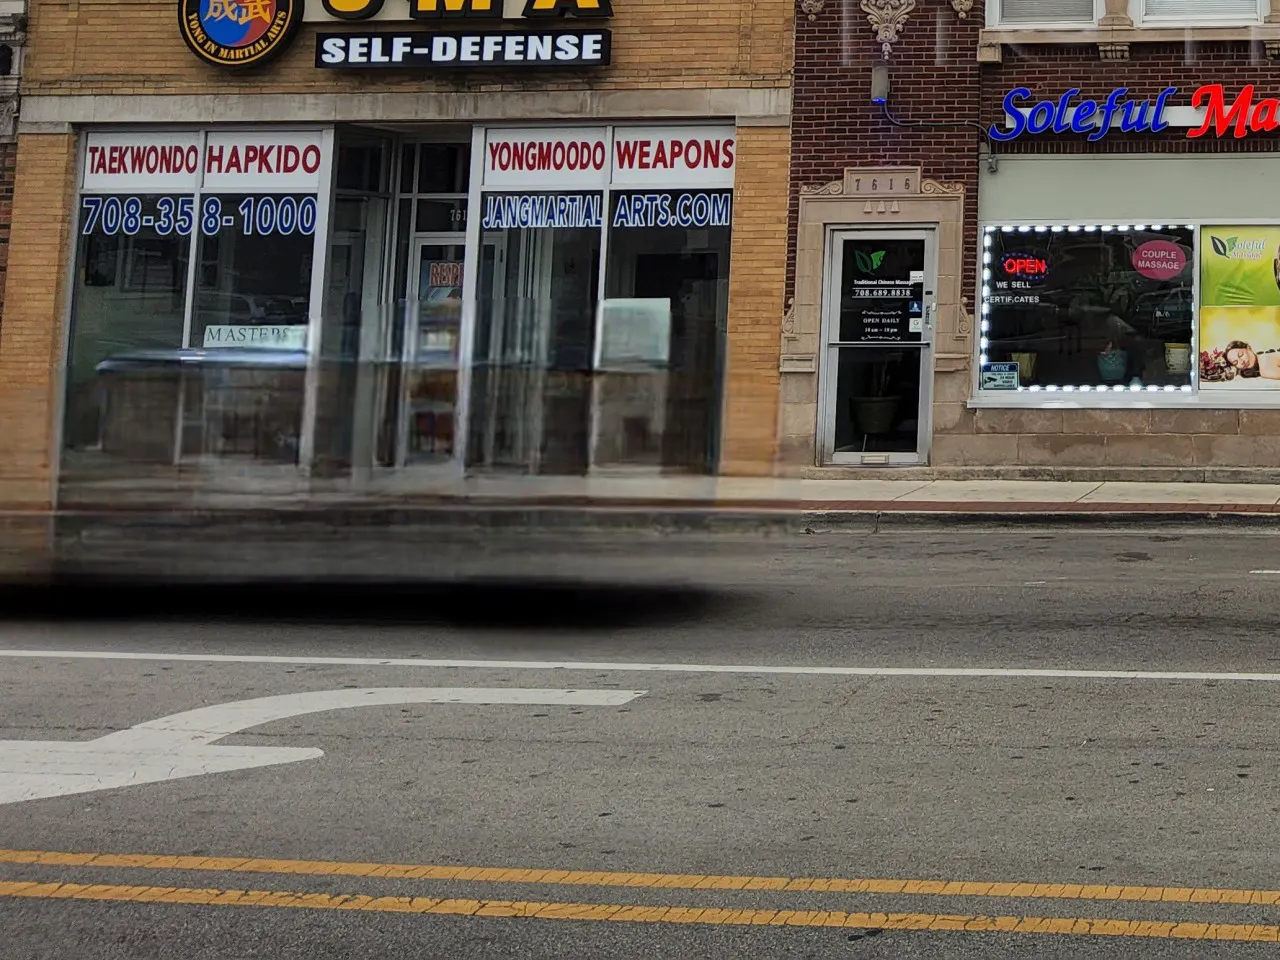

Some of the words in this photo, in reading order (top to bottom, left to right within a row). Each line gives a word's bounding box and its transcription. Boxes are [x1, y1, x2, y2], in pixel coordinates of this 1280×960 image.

[188, 11, 208, 43] YONG
[203, 39, 219, 54] IN
[217, 38, 269, 61] MARTIAL
[267, 9, 288, 39] ARTS
[321, 34, 602, 64] SELF-DEFENSE
[988, 86, 1177, 141] Soleful
[88, 144, 199, 174] TAEKWONDO
[206, 144, 321, 174] HAPKIDO
[488, 140, 606, 171] YONGMOODO
[615, 138, 735, 169] WEAPONS
[854, 177, 911, 191] 7616
[1003, 258, 1047, 274] OPEN
[1137, 260, 1180, 270] MASSAGE
[1141, 250, 1178, 259] COUPLE
[855, 289, 911, 297] 708.689.8838
[996, 281, 1009, 289] WE
[1011, 280, 1031, 289] SELL
[990, 364, 1010, 372] NOTICE
